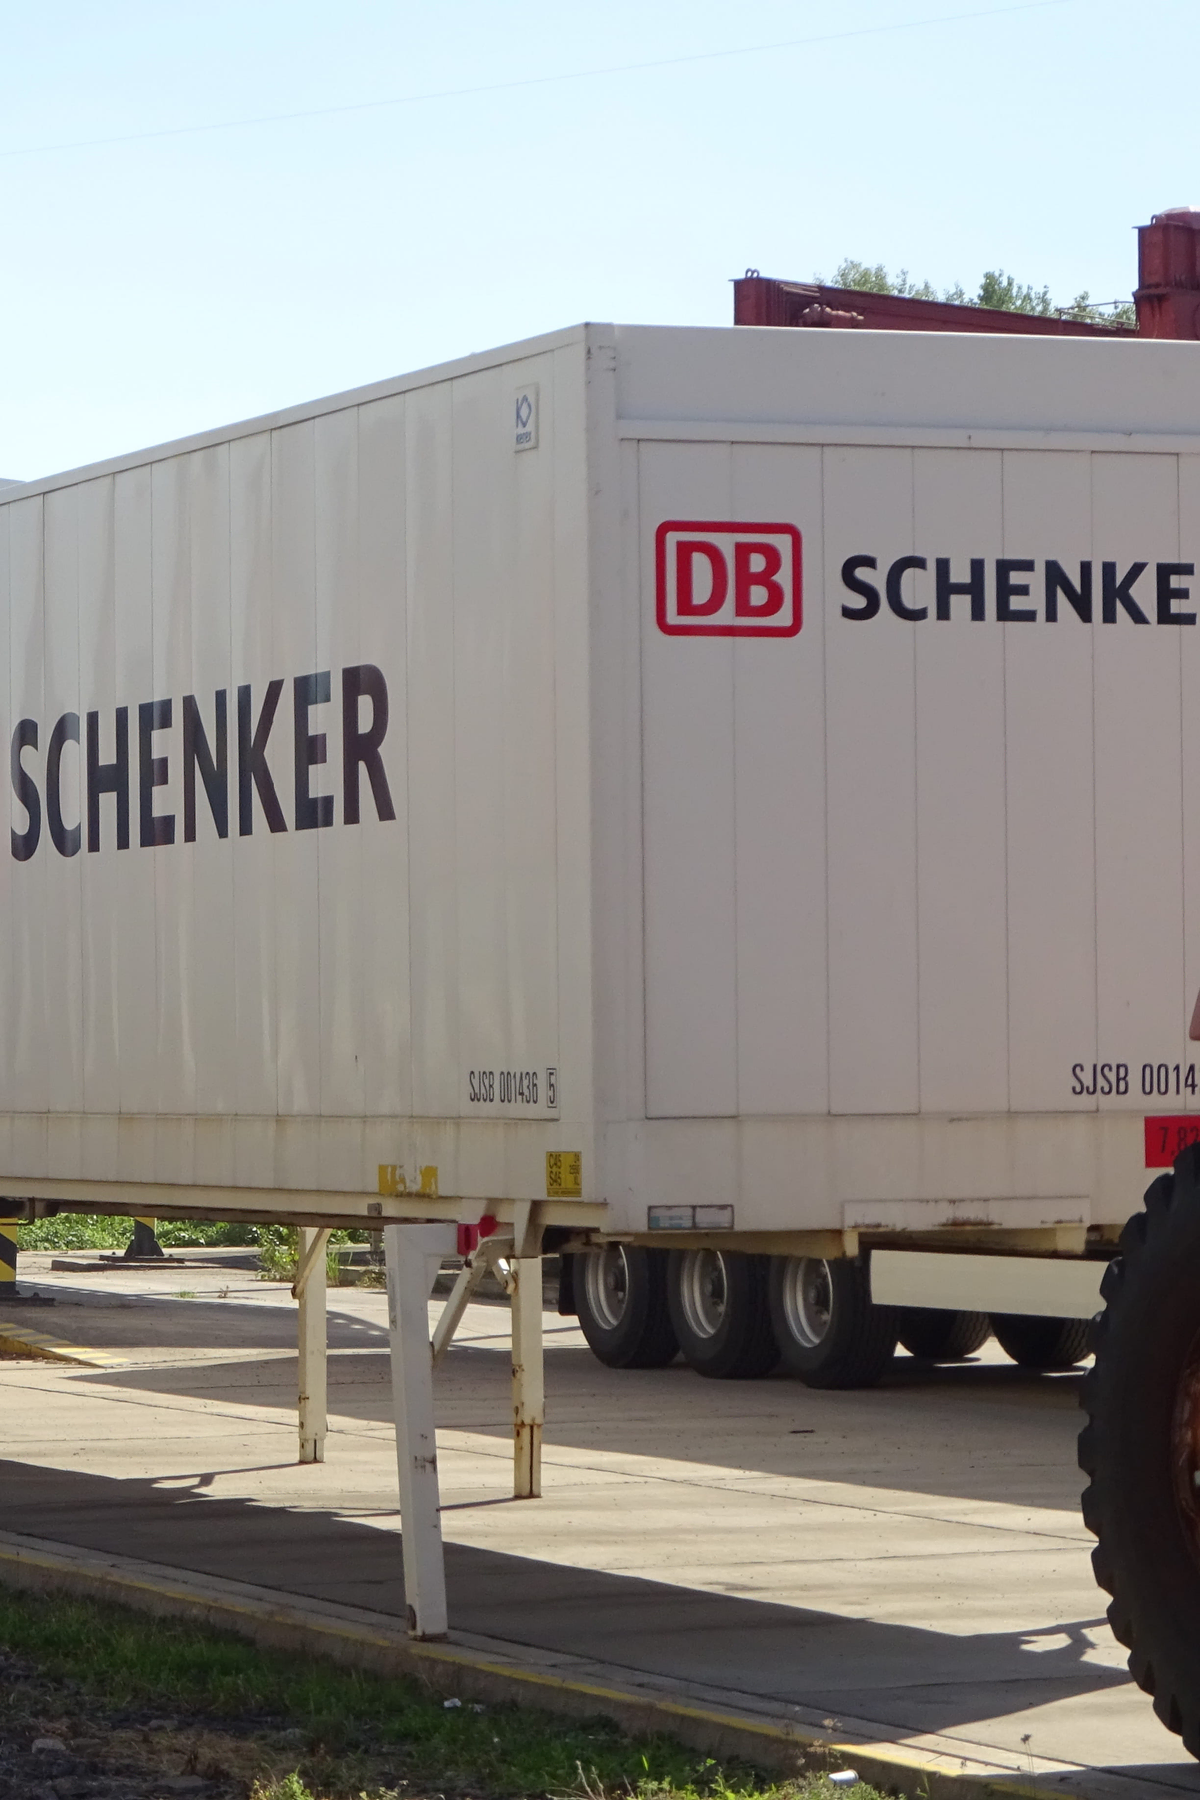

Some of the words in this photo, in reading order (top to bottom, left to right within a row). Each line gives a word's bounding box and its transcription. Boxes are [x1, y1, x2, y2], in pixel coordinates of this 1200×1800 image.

[676, 541, 784, 617] DB
[841, 555, 1198, 625] SCHENKE
[10, 664, 396, 861] SCHENKER
[469, 1070, 494, 1102] SJSB
[500, 1070, 538, 1104] 001436
[1071, 1063, 1129, 1095] SJSB
